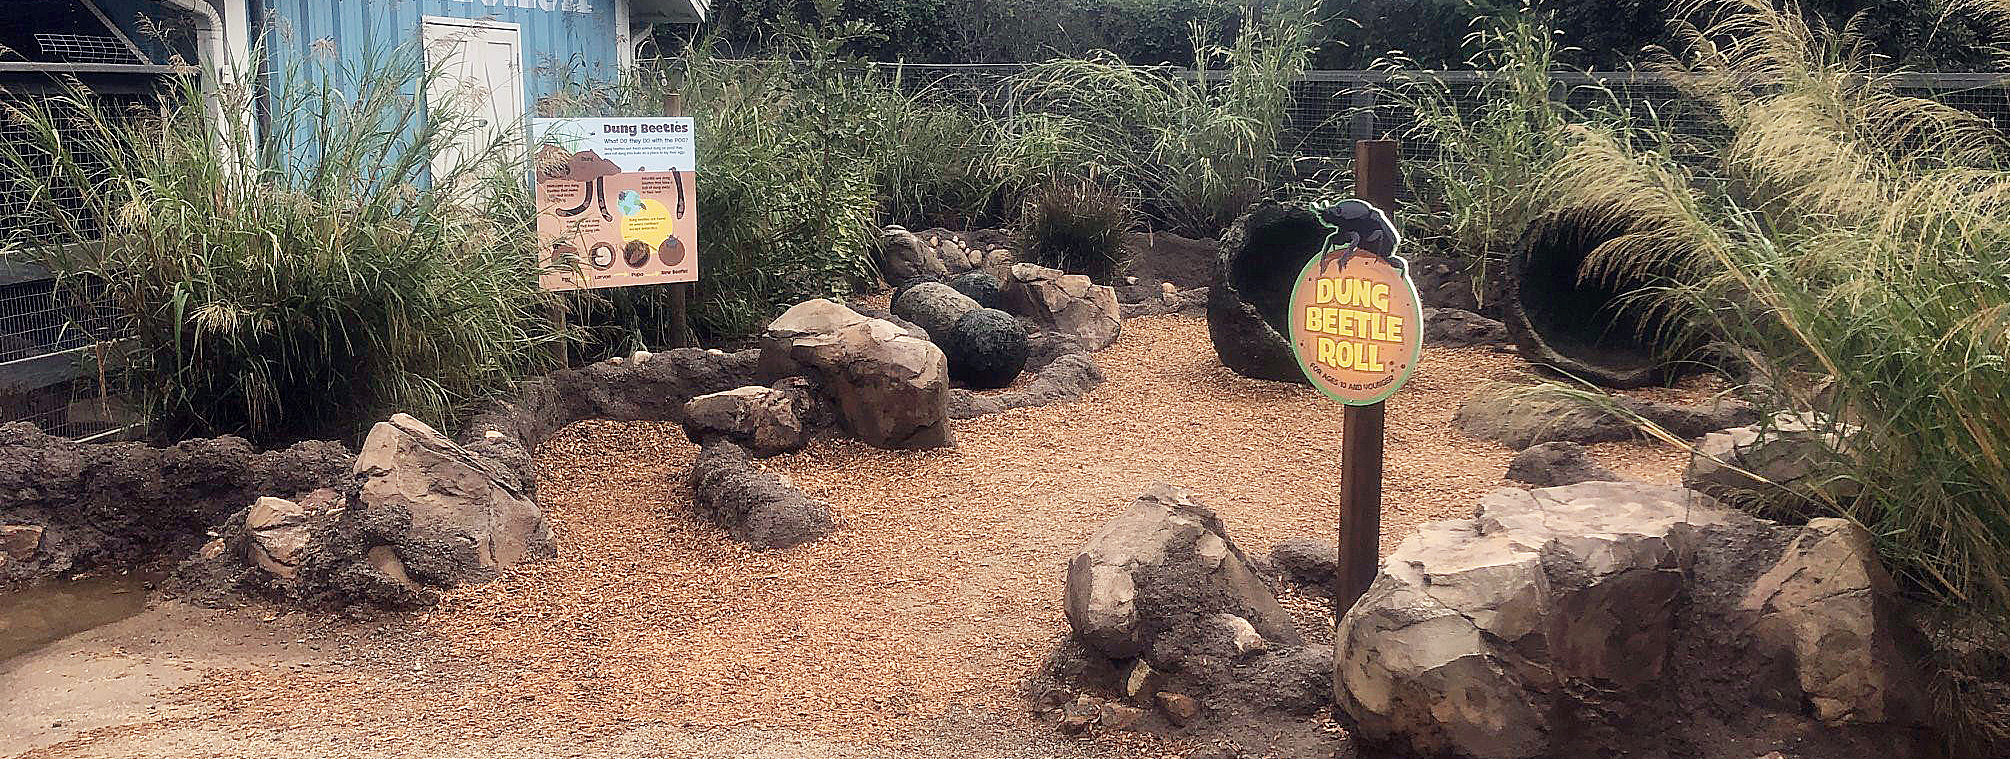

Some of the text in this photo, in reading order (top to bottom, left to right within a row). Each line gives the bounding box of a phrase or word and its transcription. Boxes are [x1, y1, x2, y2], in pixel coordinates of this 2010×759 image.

[603, 123, 688, 136] Dung Beetles
[1316, 278, 1390, 312] DUNG
[1305, 306, 1403, 342] BEETLE
[1318, 337, 1385, 372] ROLL
[1310, 362, 1321, 376] FOR
[1322, 373, 1338, 385] AGES
[1363, 375, 1394, 390] YOUNGER
